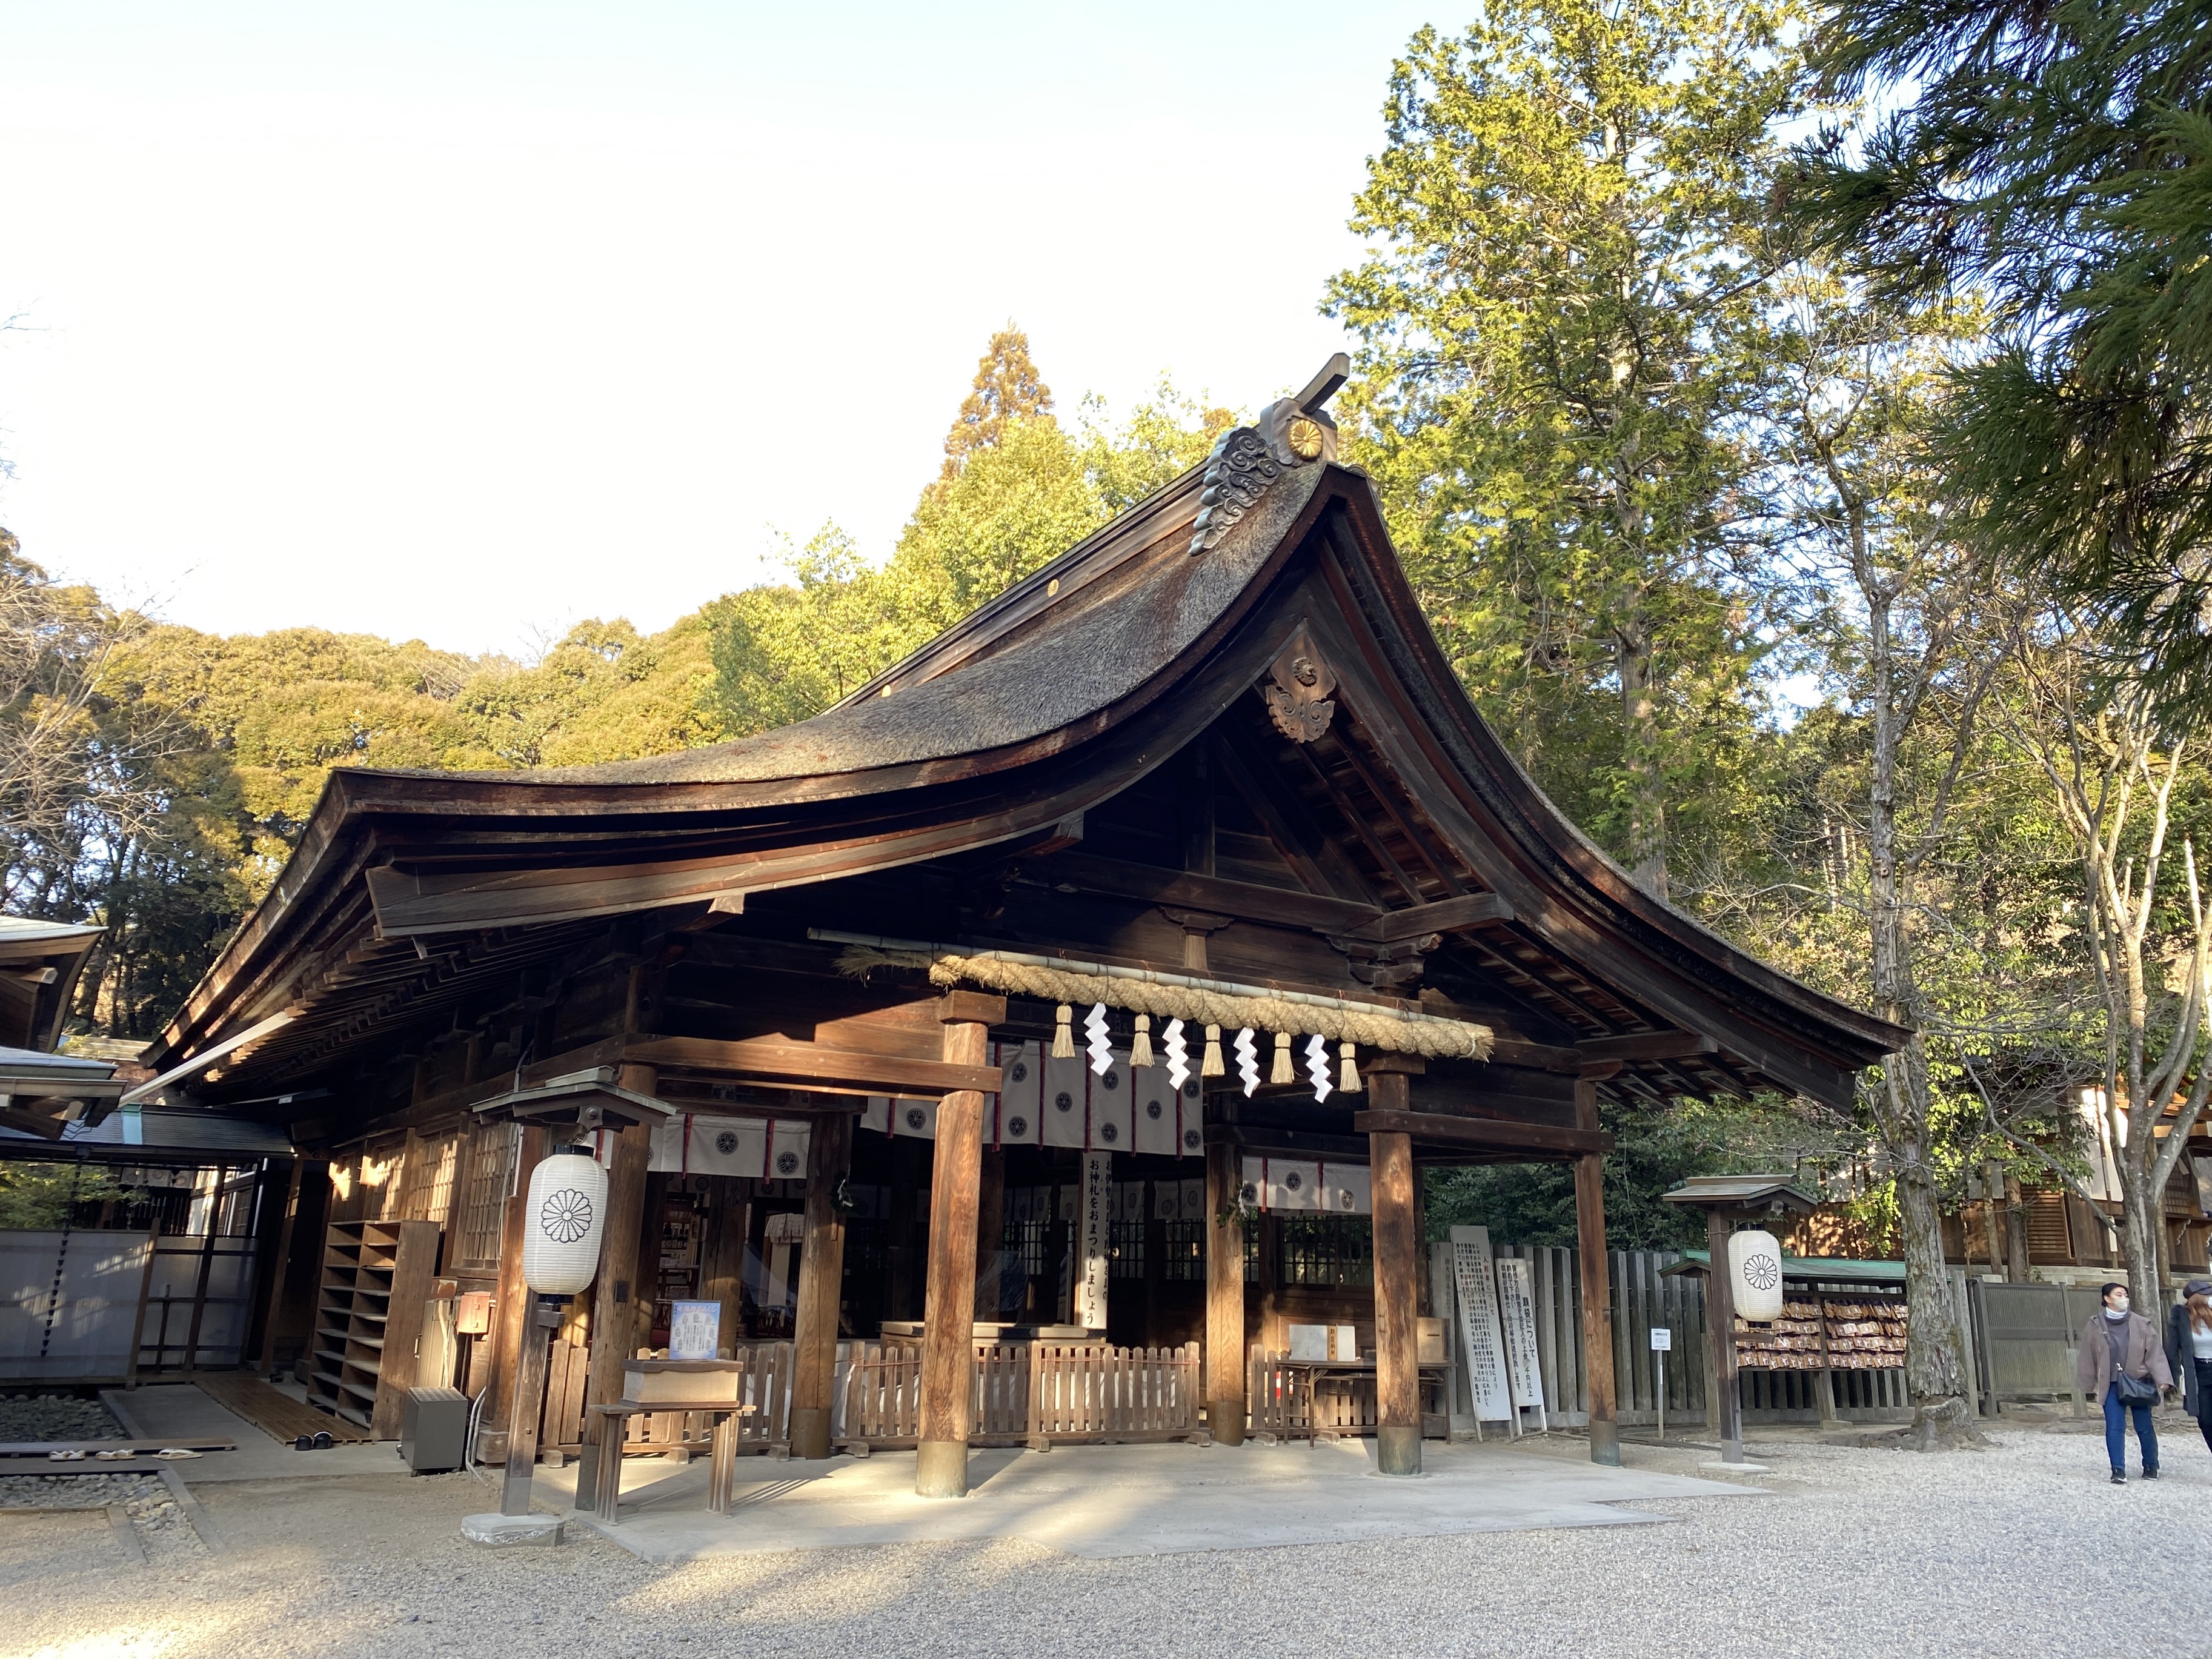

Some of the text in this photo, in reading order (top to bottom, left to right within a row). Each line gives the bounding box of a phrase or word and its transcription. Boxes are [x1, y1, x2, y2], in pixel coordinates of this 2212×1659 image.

[1086, 1159, 1100, 1325] お神札をおまつりしましょう
[1512, 1265, 1533, 1397] 皆様方の願意を御記入の上金千円以上
[1523, 1297, 1535, 1357] 願袋について
